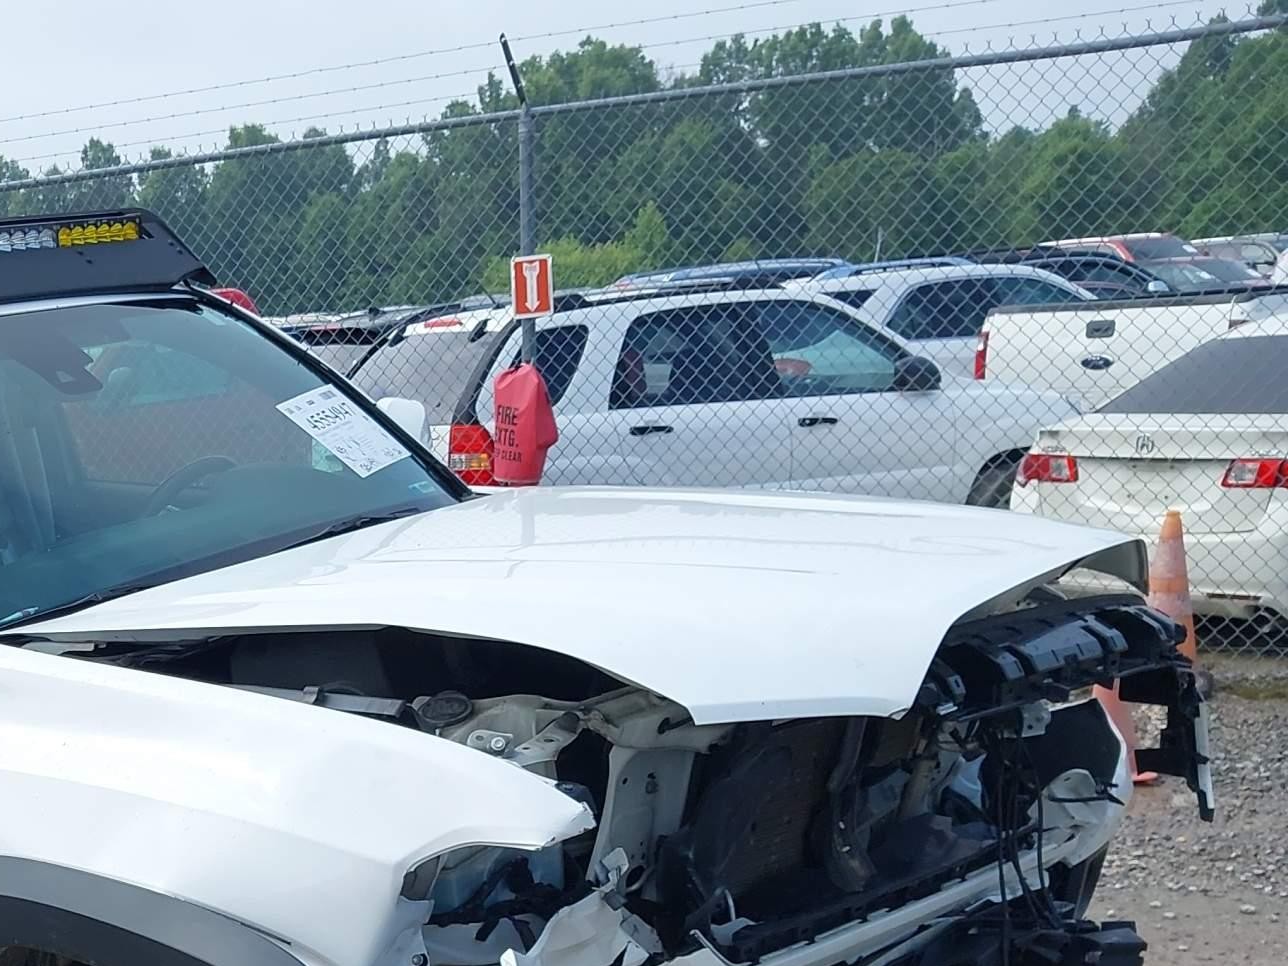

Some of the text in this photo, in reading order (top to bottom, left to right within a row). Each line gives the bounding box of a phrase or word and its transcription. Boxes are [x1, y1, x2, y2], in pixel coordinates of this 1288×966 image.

[306, 401, 358, 431] 45554947
[497, 404, 519, 426] FIRE
[501, 450, 522, 463] CLEAR
